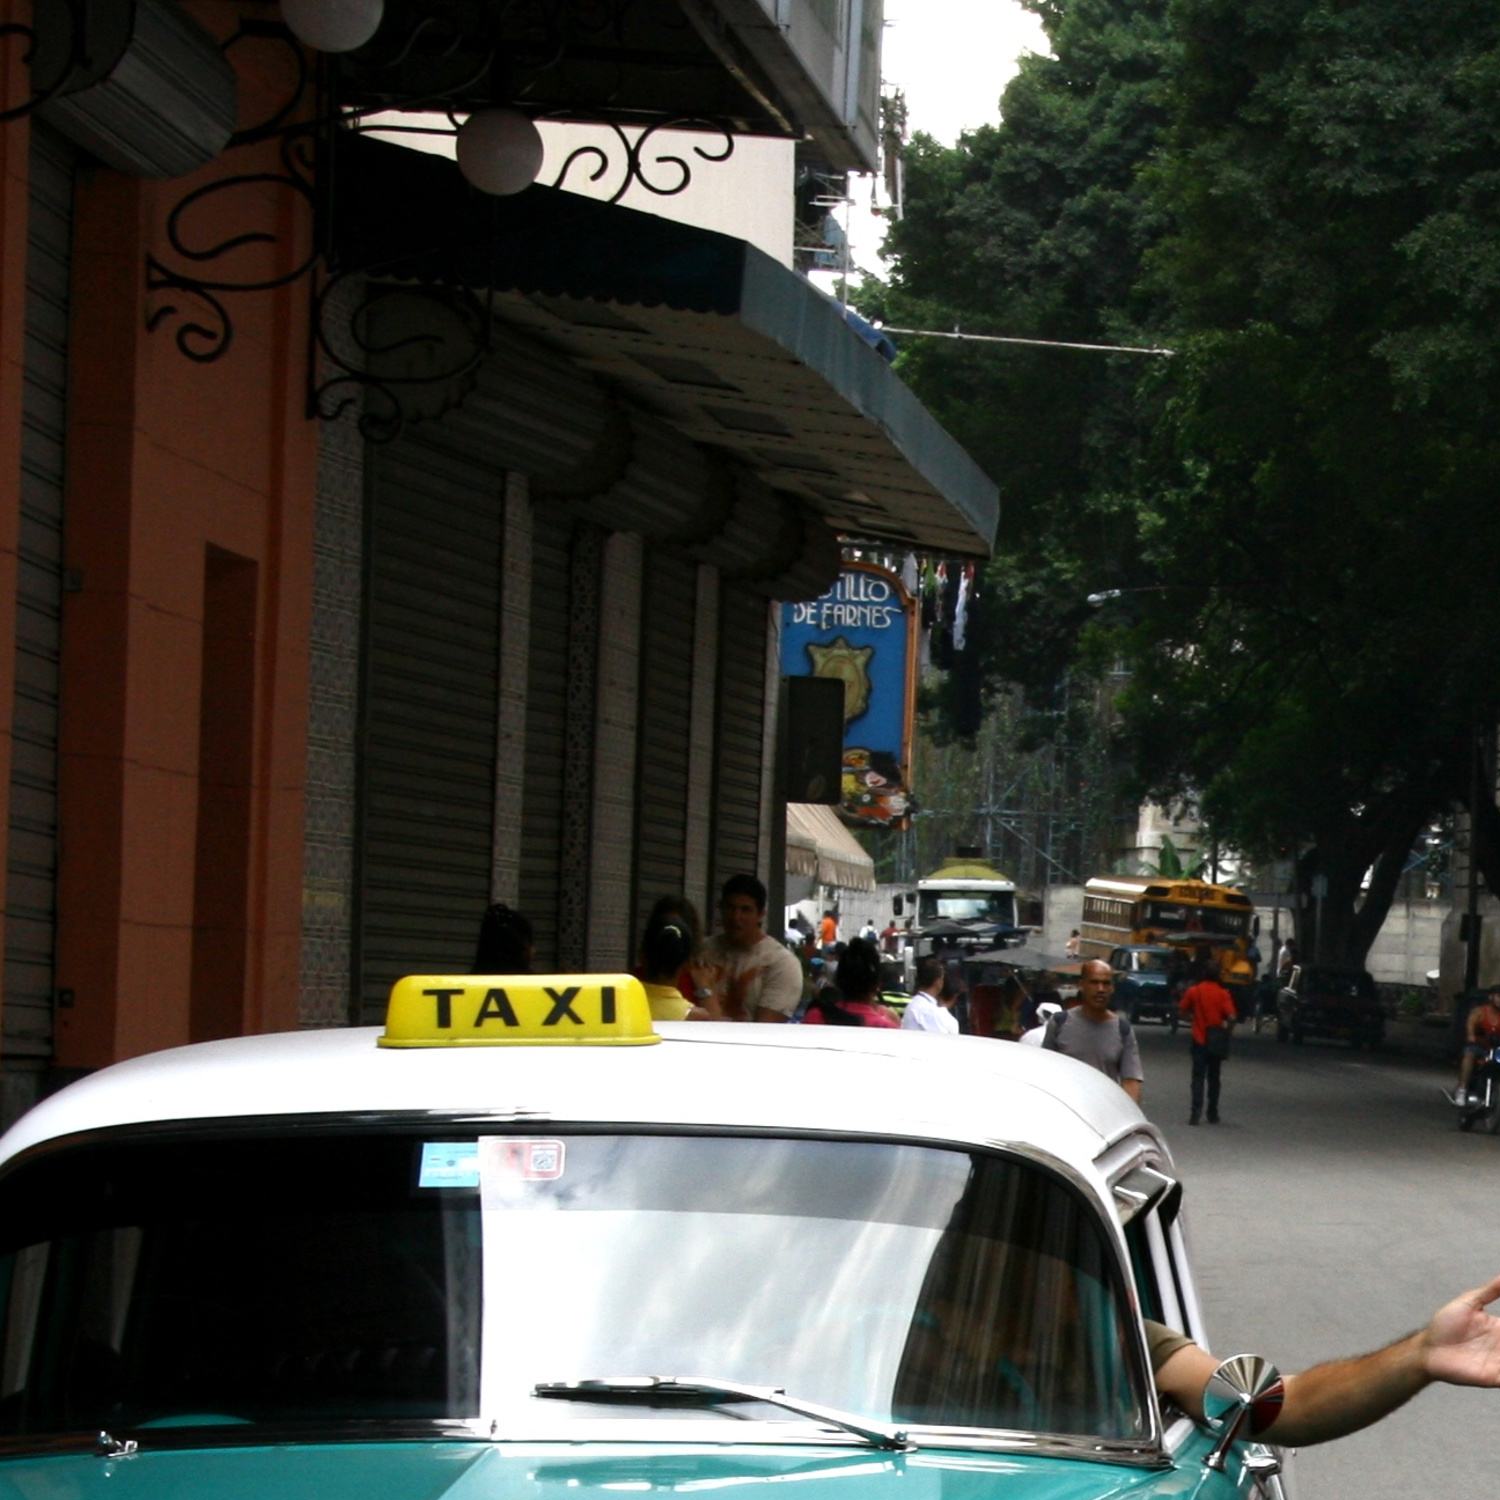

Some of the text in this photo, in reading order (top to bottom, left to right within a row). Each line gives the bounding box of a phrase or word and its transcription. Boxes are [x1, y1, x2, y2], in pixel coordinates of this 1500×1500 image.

[818, 573, 889, 602] TILLO
[793, 602, 902, 630] DE FARNES
[422, 986, 617, 1029] TAXI
